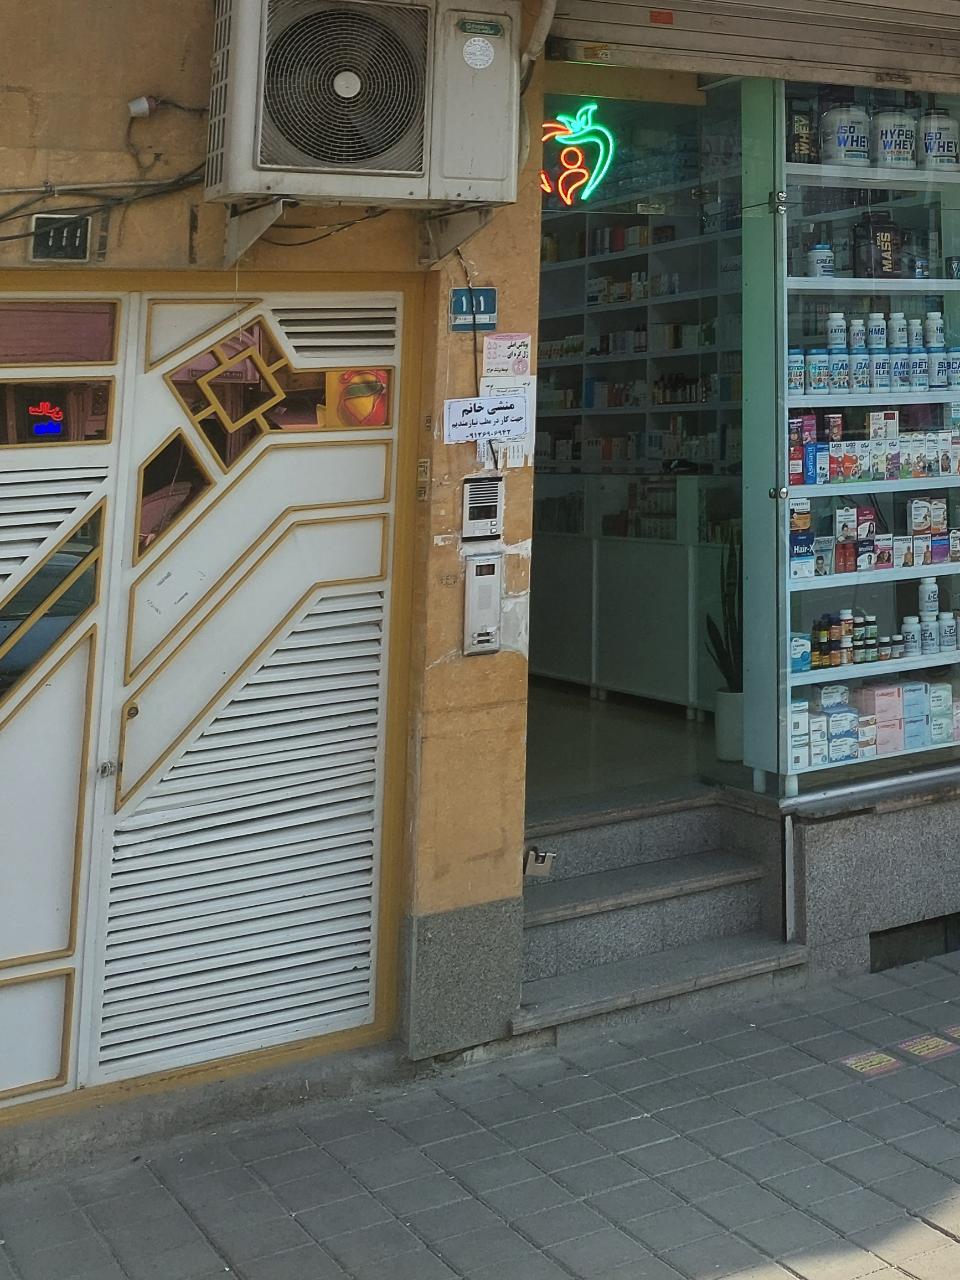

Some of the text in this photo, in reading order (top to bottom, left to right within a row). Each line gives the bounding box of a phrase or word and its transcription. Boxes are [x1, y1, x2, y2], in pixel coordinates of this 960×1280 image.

[880, 232, 893, 272] MASS
[461, 401, 515, 418] منشی خانم
[493, 418, 499, 426] در
[500, 415, 509, 426] کار
